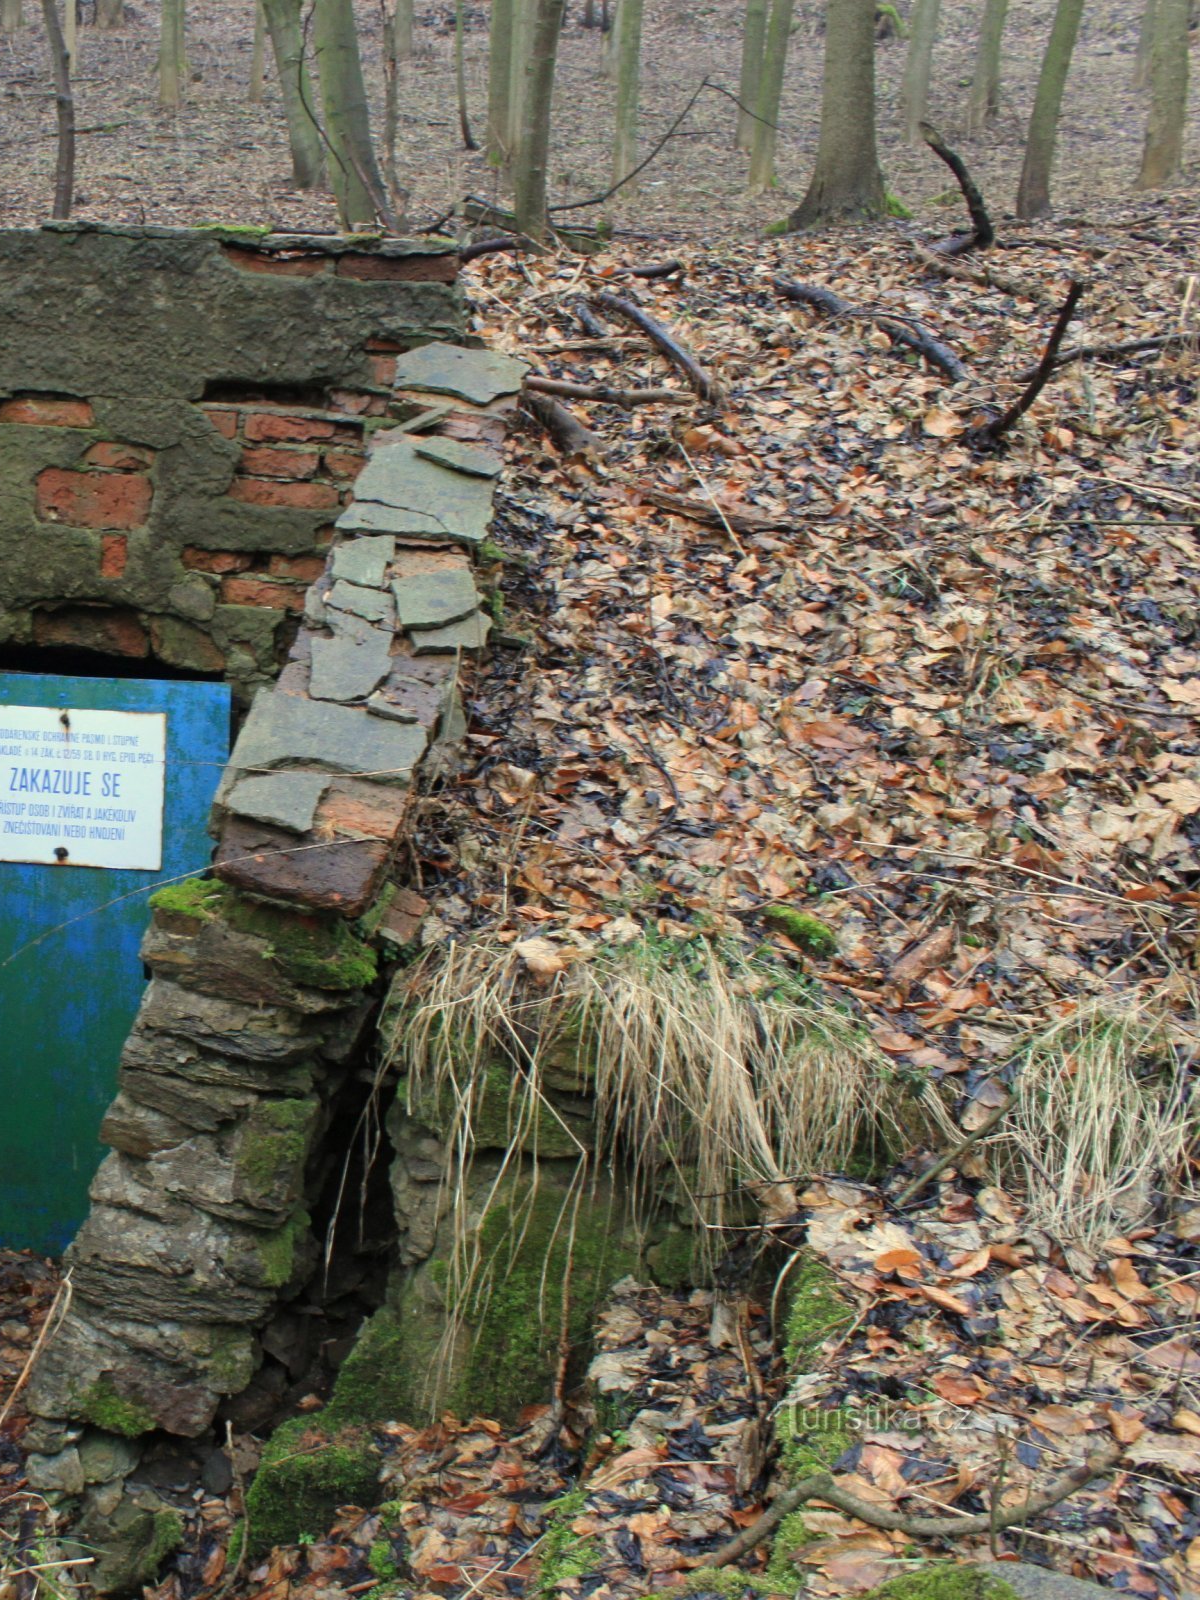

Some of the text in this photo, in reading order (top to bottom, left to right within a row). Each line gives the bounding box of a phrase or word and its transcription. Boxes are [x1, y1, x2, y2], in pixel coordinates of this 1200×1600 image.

[10, 767, 121, 797] ZAKAZUJE SE
[29, 804, 50, 817] OSOB
[86, 809, 92, 820] A
[64, 825, 86, 839] NEBO
